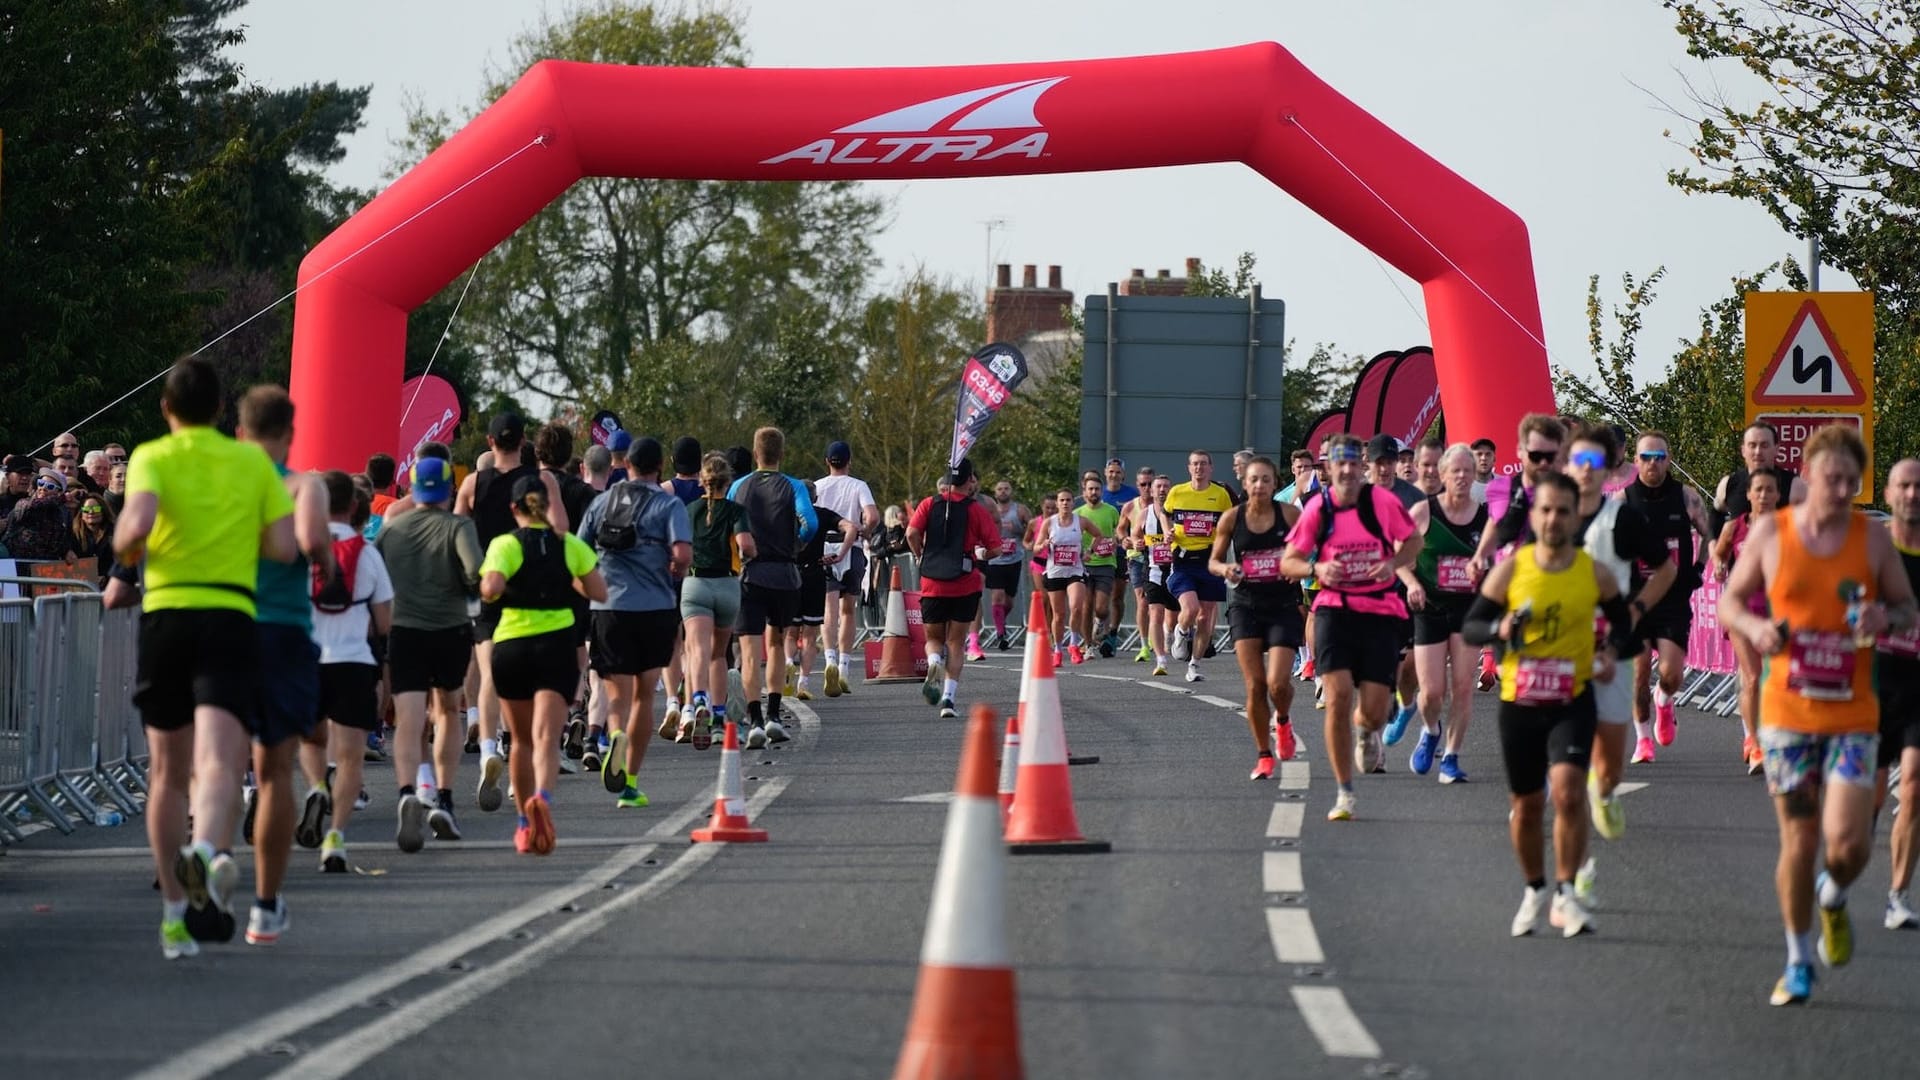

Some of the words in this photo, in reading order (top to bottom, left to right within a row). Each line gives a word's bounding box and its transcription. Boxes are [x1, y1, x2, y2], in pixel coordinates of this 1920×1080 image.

[758, 131, 1049, 165] ALTRA
[969, 369, 1004, 404] 03:45
[1775, 446, 1802, 463] SP
[1502, 461, 1524, 475] OU
